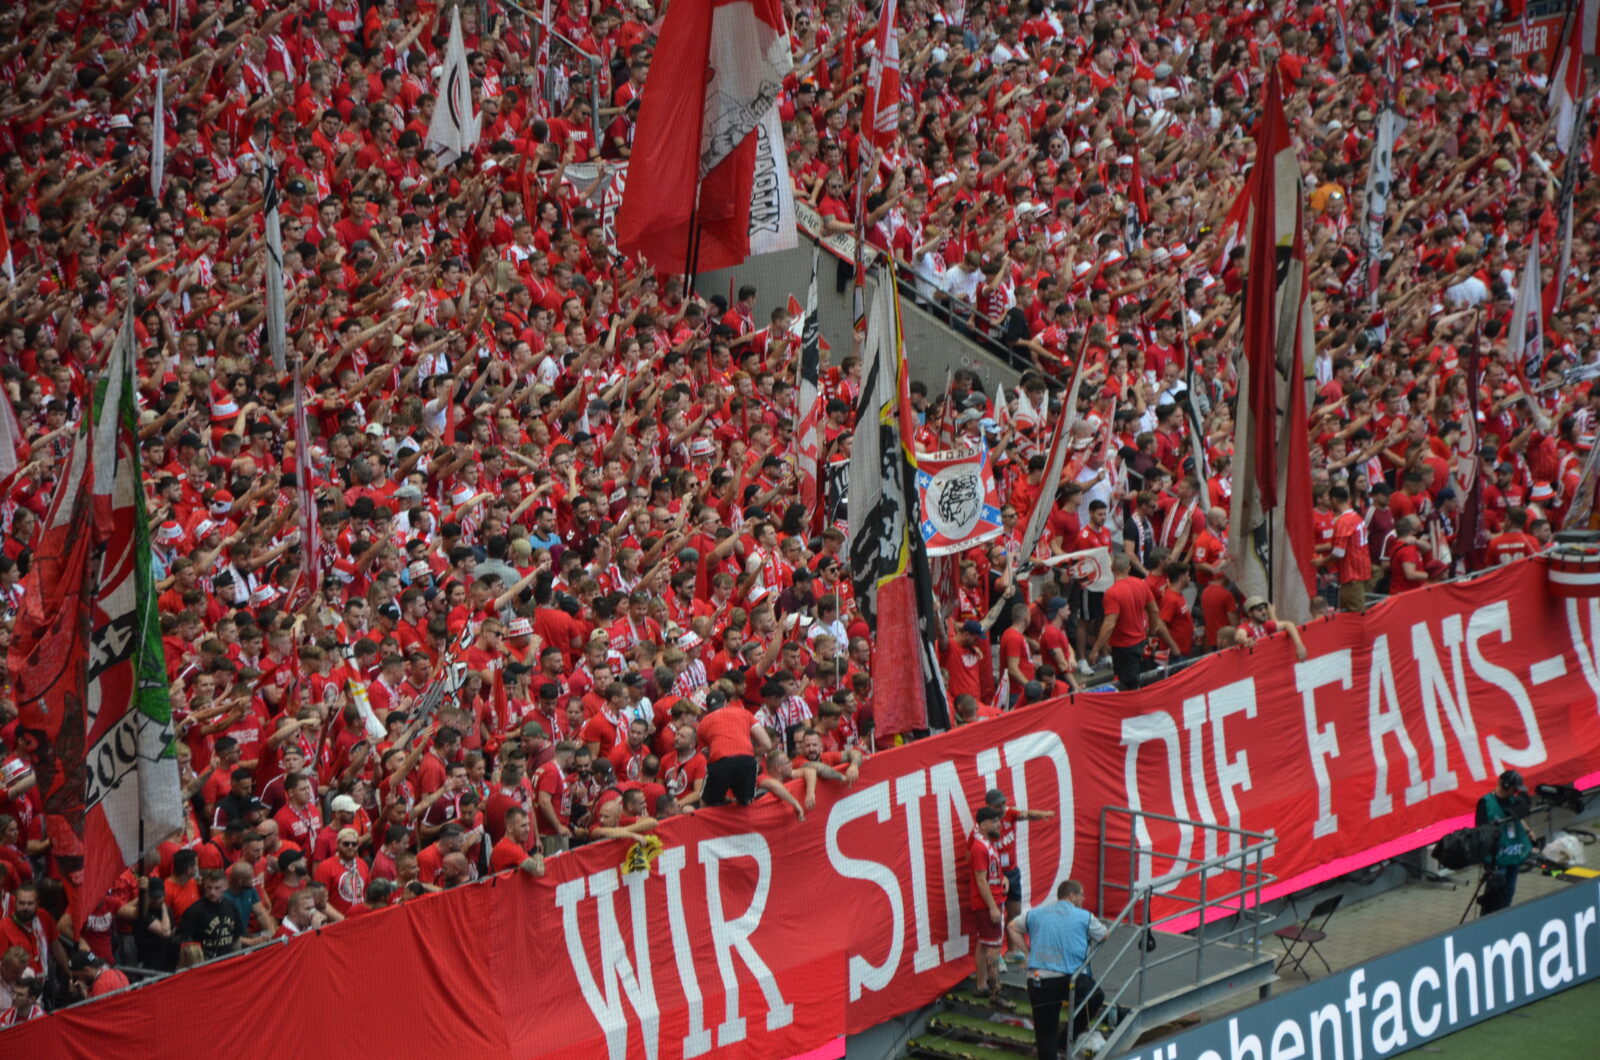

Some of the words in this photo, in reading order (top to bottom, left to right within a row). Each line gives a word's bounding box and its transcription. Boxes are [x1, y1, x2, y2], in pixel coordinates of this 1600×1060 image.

[555, 832, 794, 1060] WIR
[825, 730, 1075, 1003] SIND
[1120, 677, 1277, 893] DIE
[1127, 883, 1600, 1060] henfachmar
